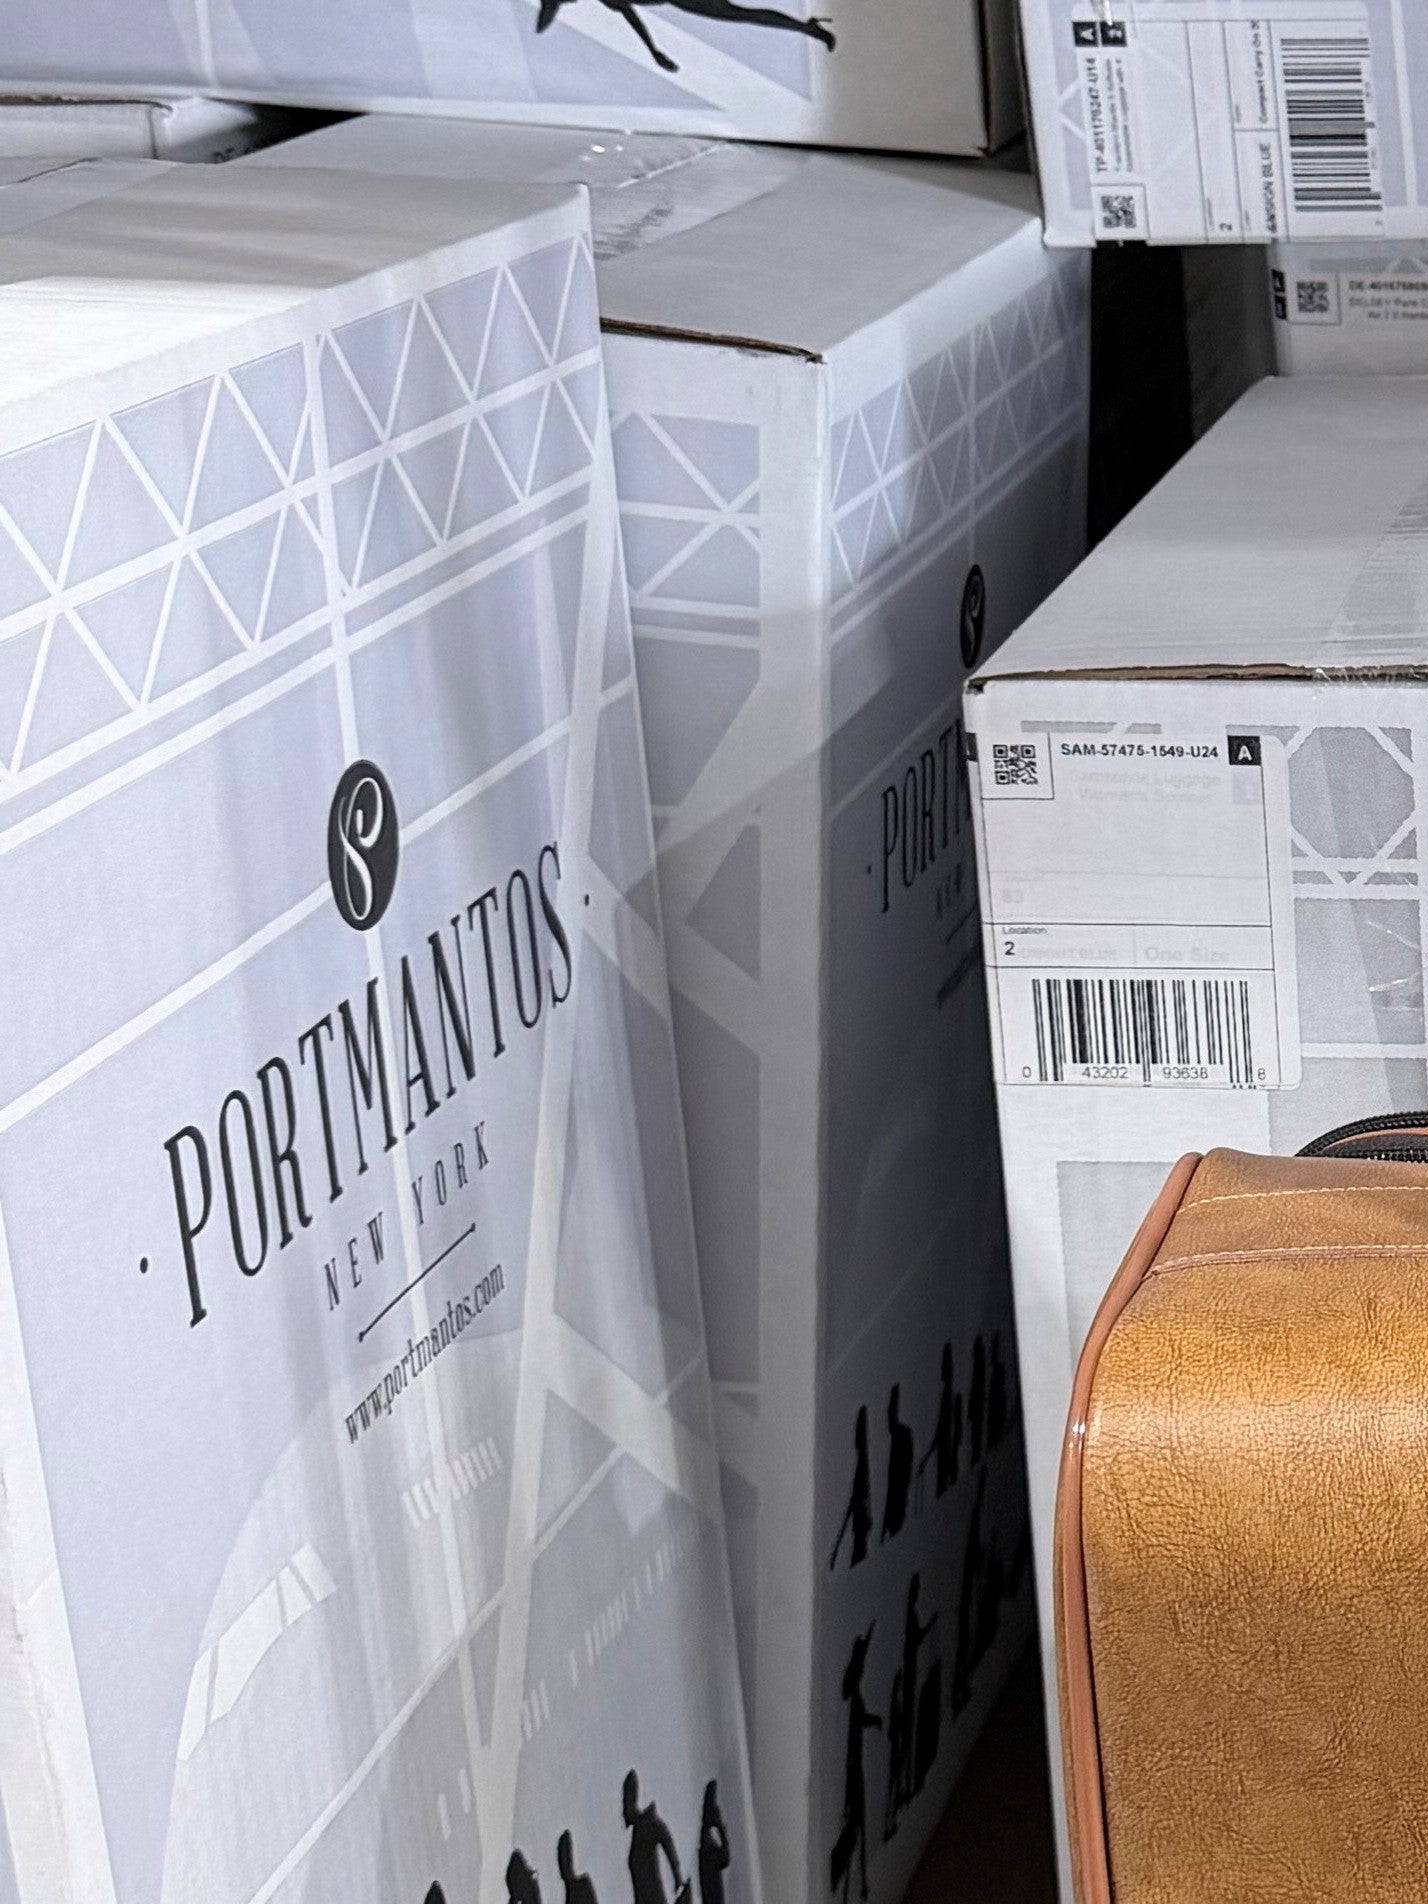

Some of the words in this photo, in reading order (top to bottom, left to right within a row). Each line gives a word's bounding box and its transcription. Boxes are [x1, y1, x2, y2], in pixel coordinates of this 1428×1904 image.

[1236, 745, 1253, 762] A
[1002, 926, 1048, 937] Location
[1004, 941, 1016, 956] 2
[1021, 1065, 1032, 1079] 0
[1081, 1065, 1129, 1079] 43202
[1162, 1066, 1209, 1080] 93638
[1257, 1067, 1267, 1080] 8
[164, 839, 573, 1330] PORTMANTOS
[324, 1211, 387, 1312] NEW
[410, 1118, 492, 1231] YORK
[342, 1260, 507, 1447] www.portmantos.com
